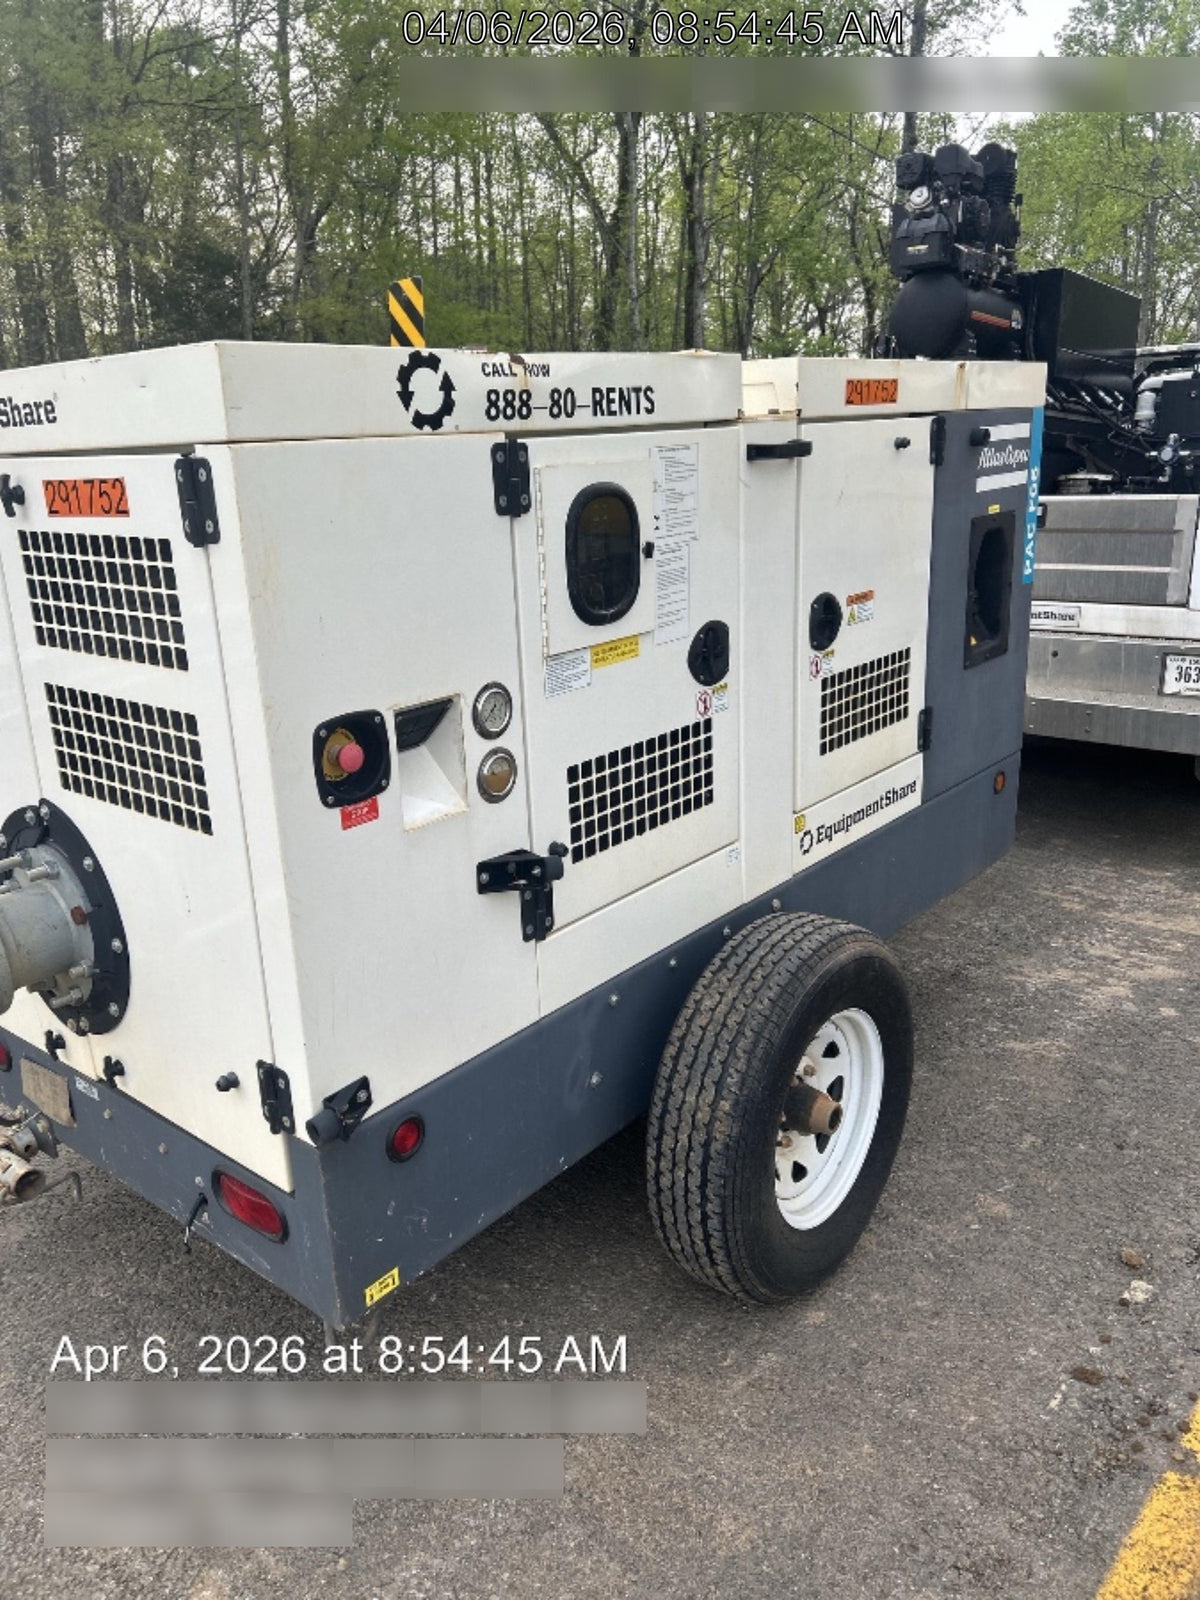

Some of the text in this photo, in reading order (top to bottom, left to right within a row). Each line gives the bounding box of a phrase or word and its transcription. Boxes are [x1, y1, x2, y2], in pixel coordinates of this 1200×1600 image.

[481, 362, 551, 377] CALL NOW
[485, 385, 656, 421] 888-80-RENTS
[846, 379, 898, 405] 291752
[45, 478, 130, 515] 291752
[1024, 523, 1035, 575] PAC
[816, 780, 917, 845] EquipmentShare
